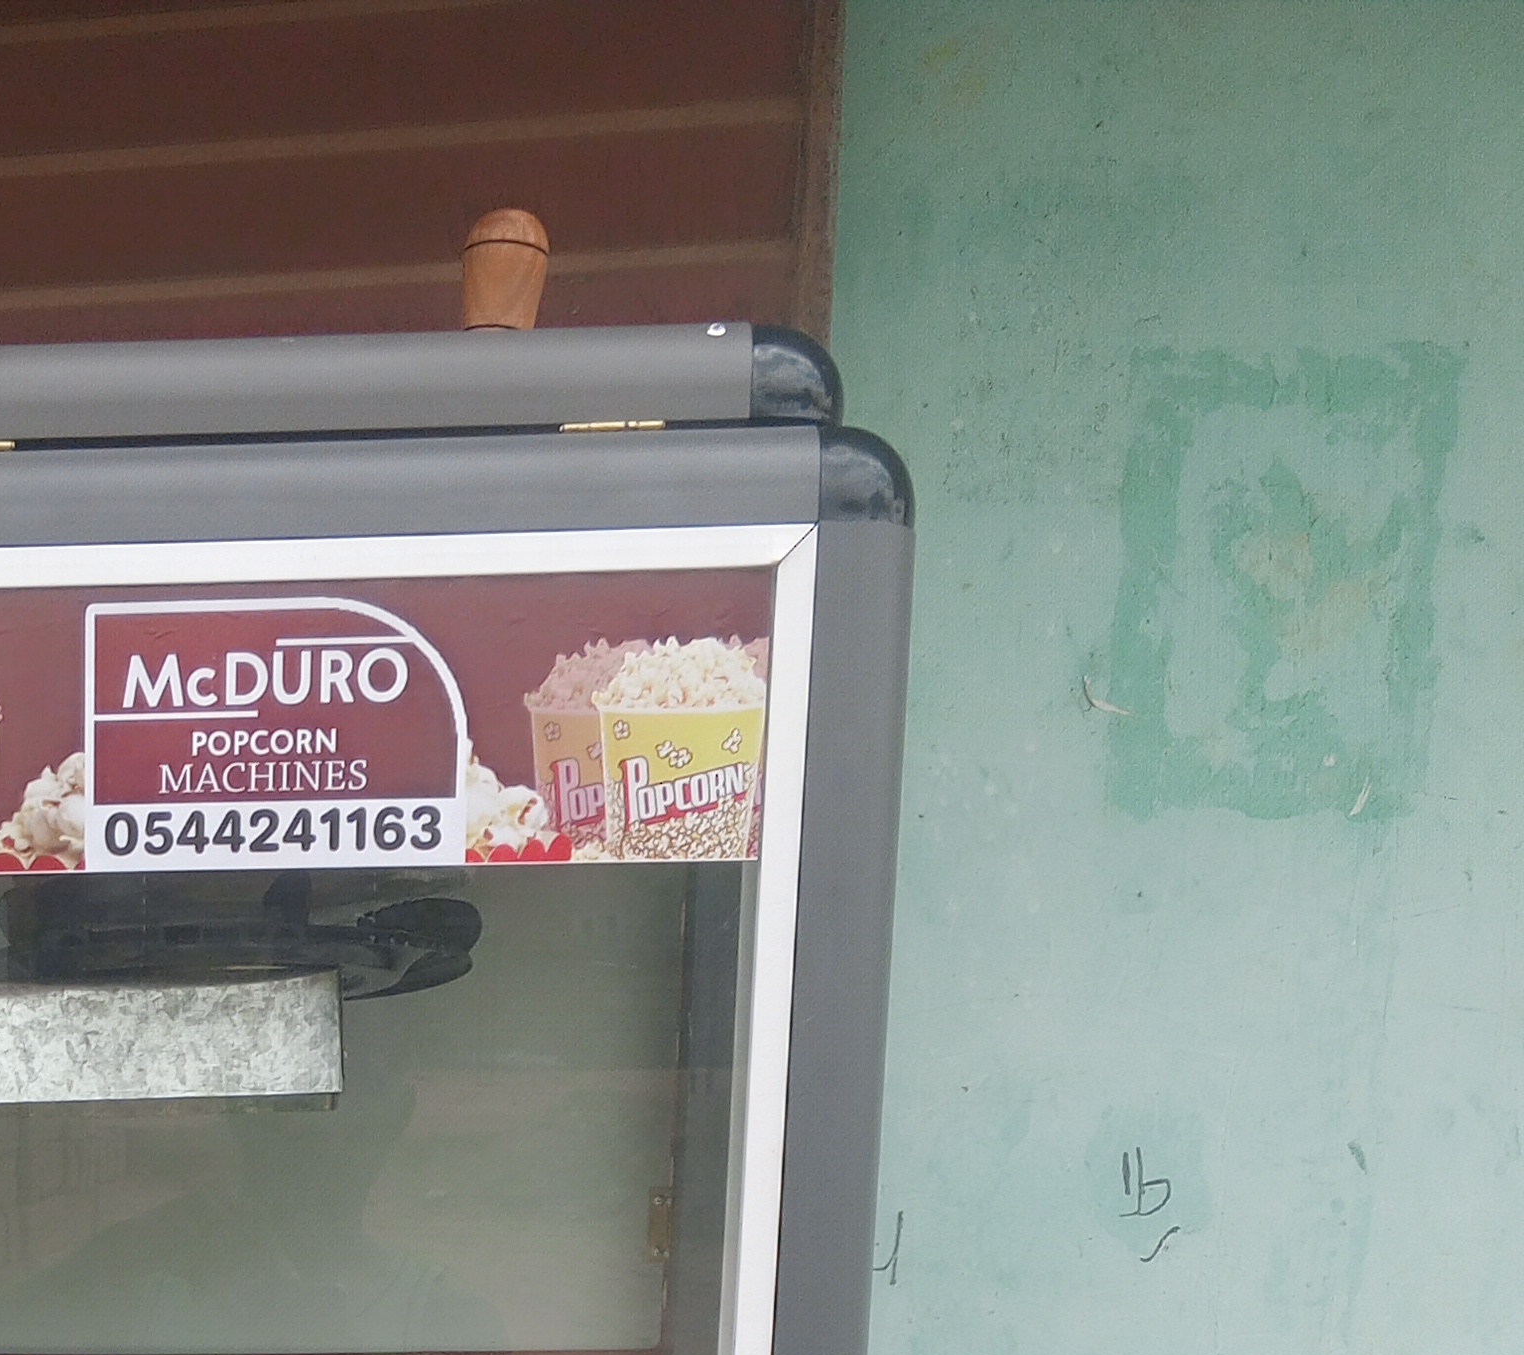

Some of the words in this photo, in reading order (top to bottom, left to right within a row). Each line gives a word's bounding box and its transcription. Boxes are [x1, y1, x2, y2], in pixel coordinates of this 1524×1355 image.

[122, 647, 409, 709] McDURO
[190, 728, 338, 757] POPCORN
[157, 758, 368, 795] MACHINES
[621, 756, 746, 826] POPCORN
[104, 805, 442, 857] 0544241163
